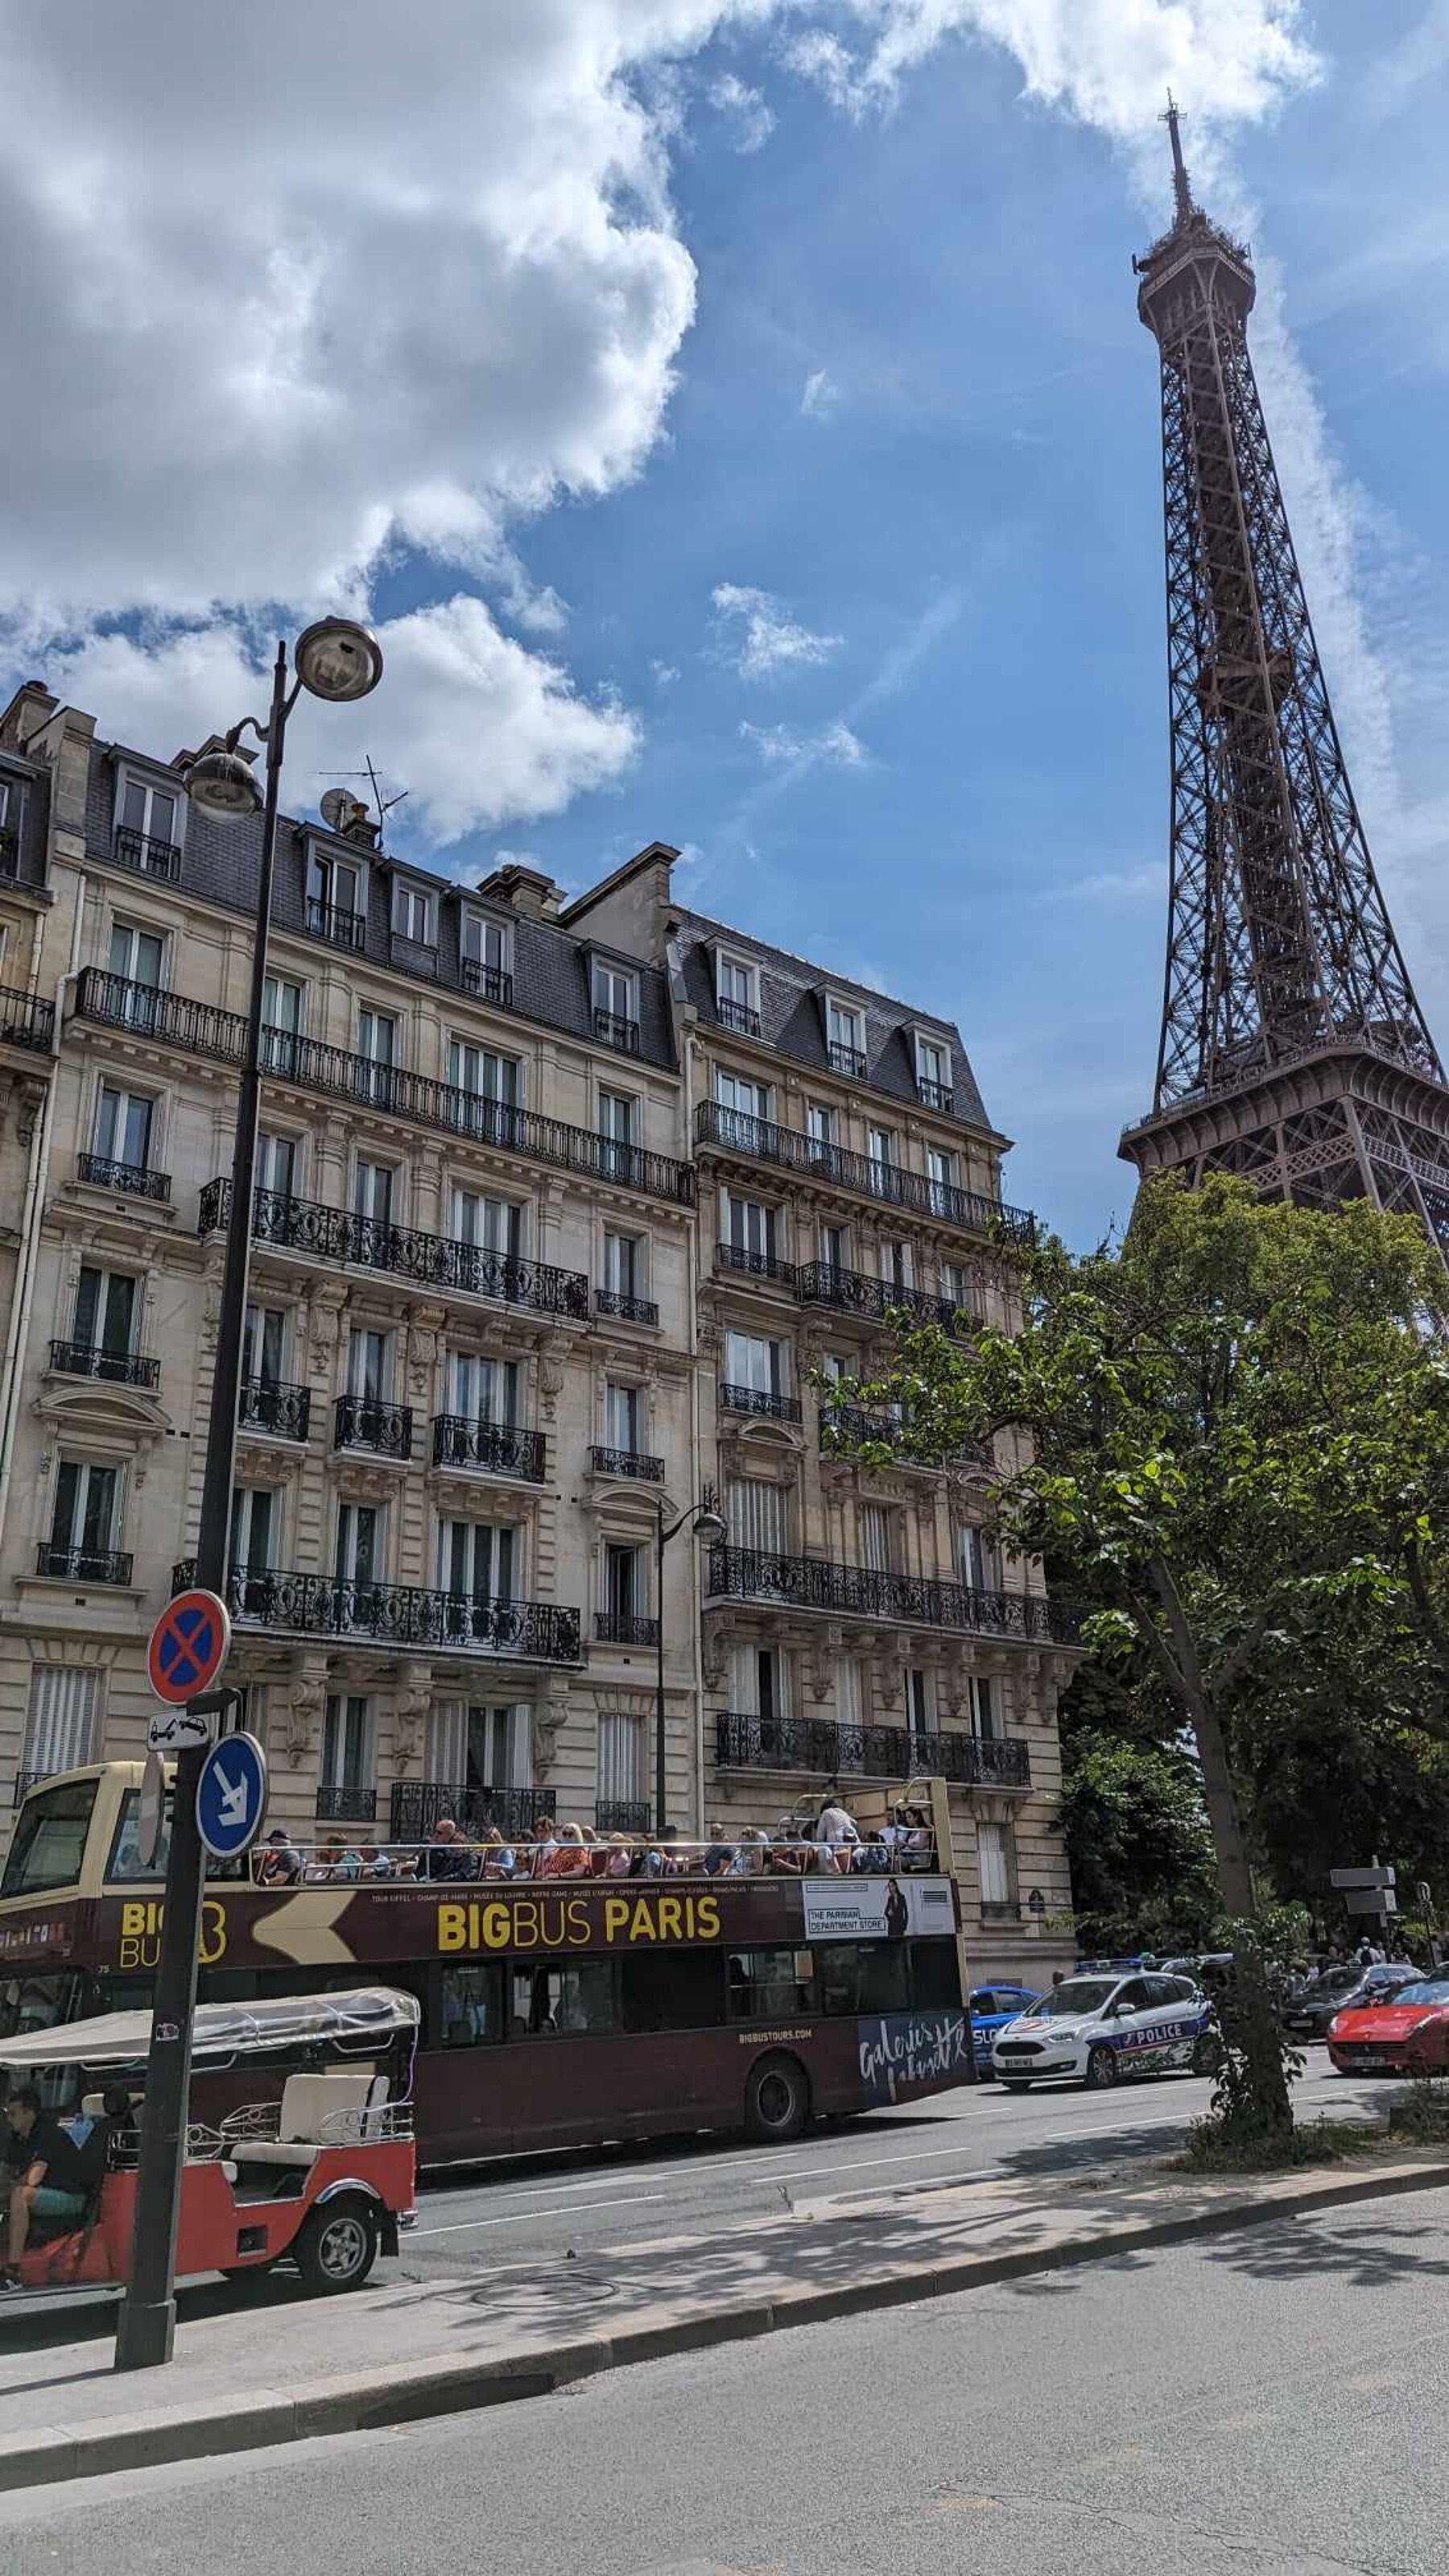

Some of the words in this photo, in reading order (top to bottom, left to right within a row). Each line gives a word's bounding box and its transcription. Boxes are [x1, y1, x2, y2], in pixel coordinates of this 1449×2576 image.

[605, 1896, 720, 1943] PARIS
[811, 1911, 825, 1920] THE
[826, 1910, 860, 1920] PARISIAN
[811, 1921, 858, 1930] DEPARTMENT
[859, 1920, 883, 1929] STORE
[739, 2029, 812, 2044] BIGBUSTOURS.COM
[1137, 2023, 1183, 2045] POLICE
